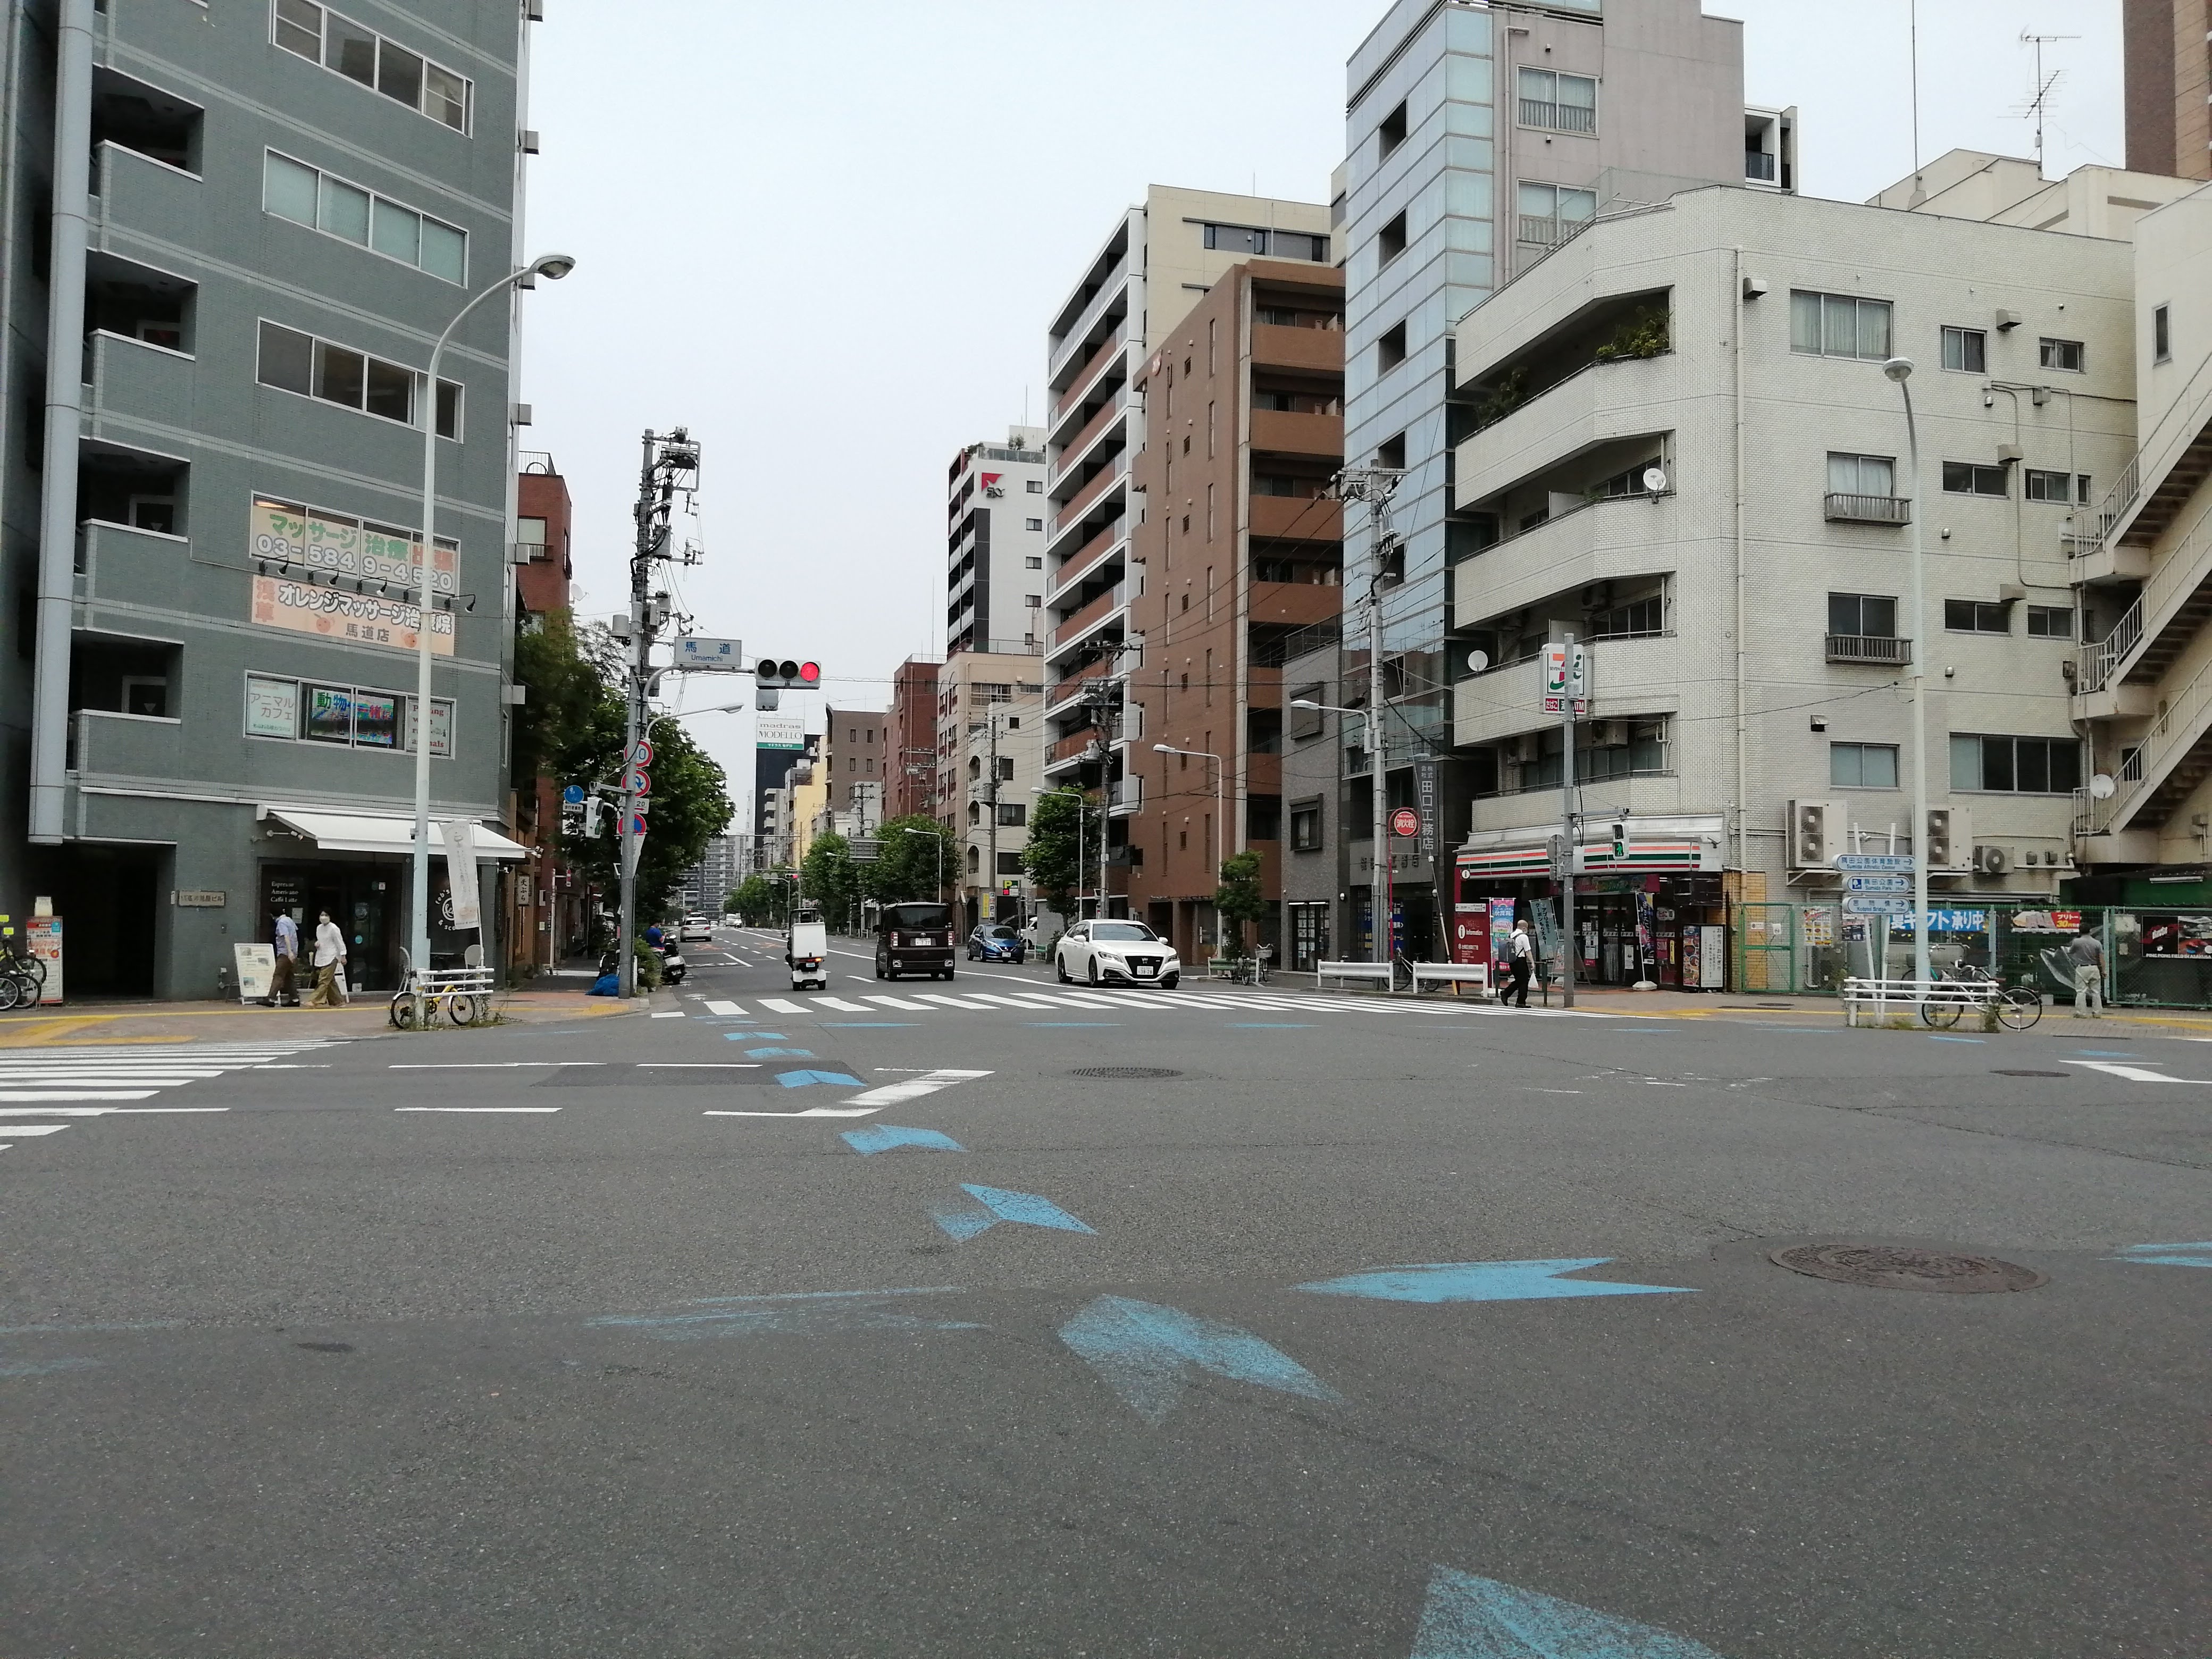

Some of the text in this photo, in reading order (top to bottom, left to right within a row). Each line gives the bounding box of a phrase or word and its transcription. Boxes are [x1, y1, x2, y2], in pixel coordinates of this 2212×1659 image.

[256, 580, 275, 622] 浅草
[345, 623, 390, 642] 馬道店
[250, 693, 294, 708] アニマル
[261, 707, 292, 720] カフェ
[413, 705, 444, 717] Ping
[759, 731, 802, 739] MODELLO
[639, 748, 647, 760] 0
[1421, 781, 1434, 850] 田口工務店
[1397, 819, 1414, 828] 消火栓
[1657, 941, 1667, 950] SIM
